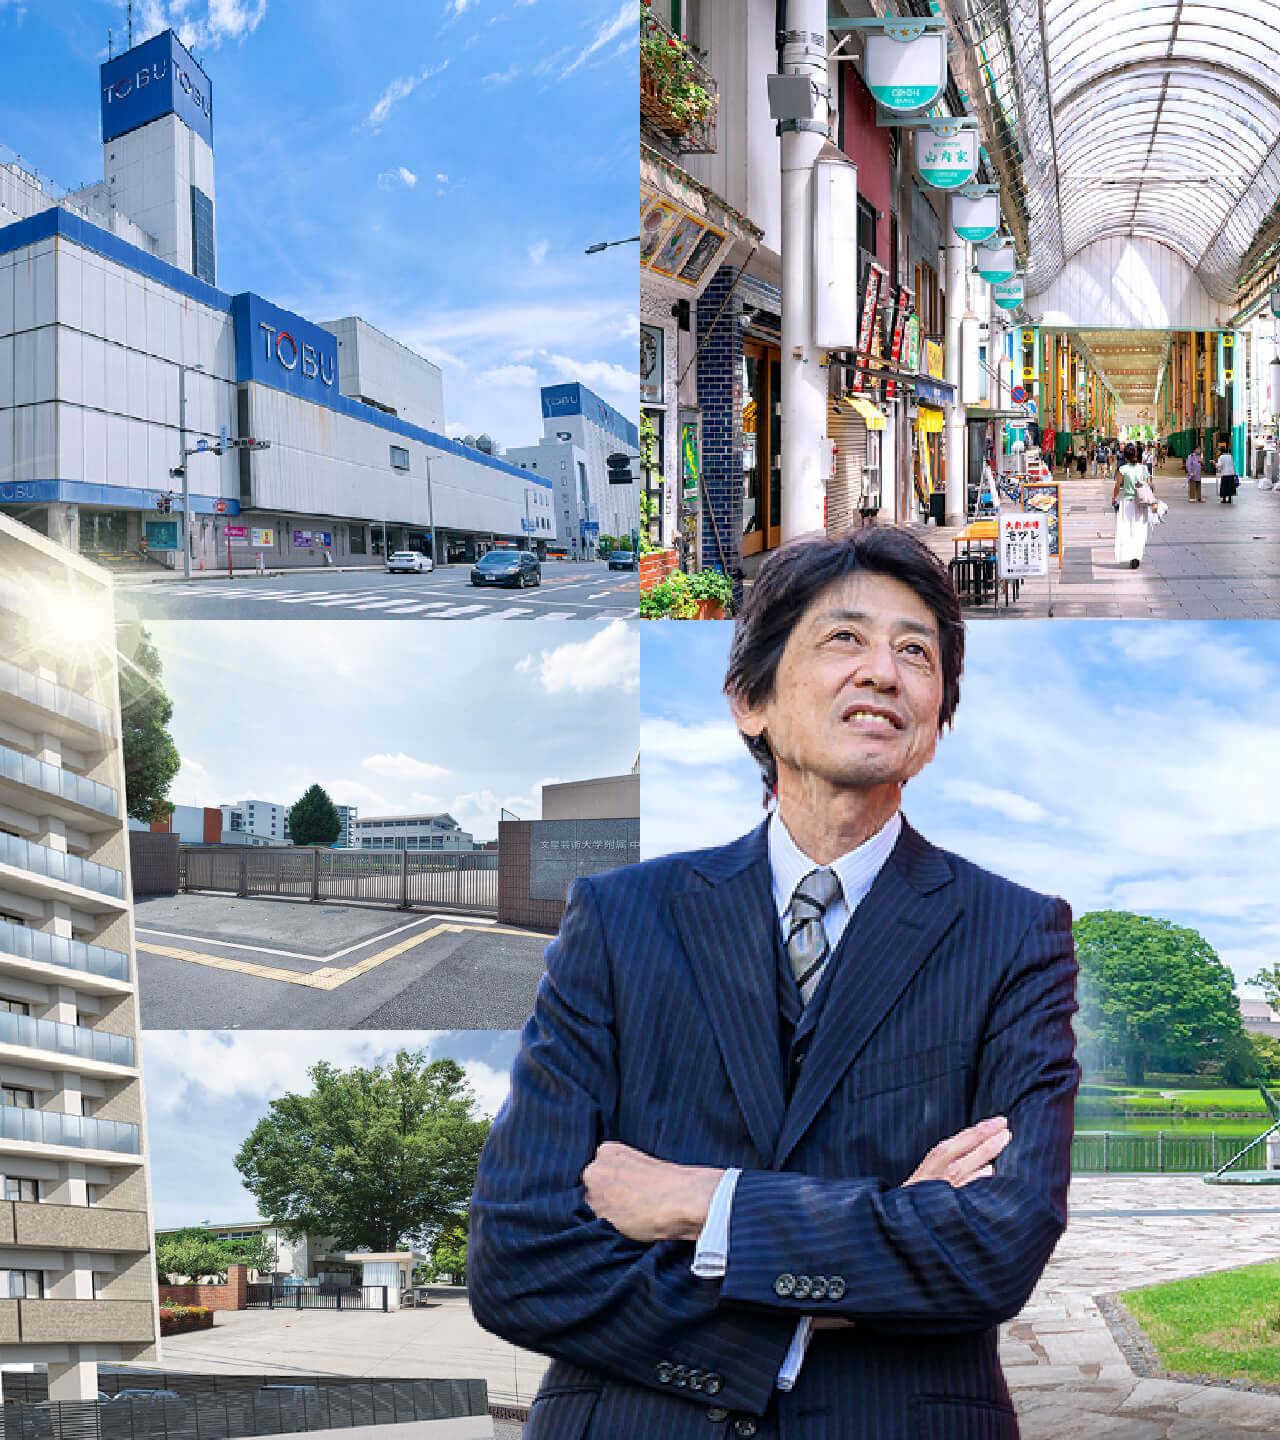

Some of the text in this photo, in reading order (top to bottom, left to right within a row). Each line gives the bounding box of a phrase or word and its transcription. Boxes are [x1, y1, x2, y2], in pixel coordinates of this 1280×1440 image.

[104, 58, 166, 104] TOBU
[172, 58, 210, 118] TOBU
[260, 321, 335, 386] TOBU
